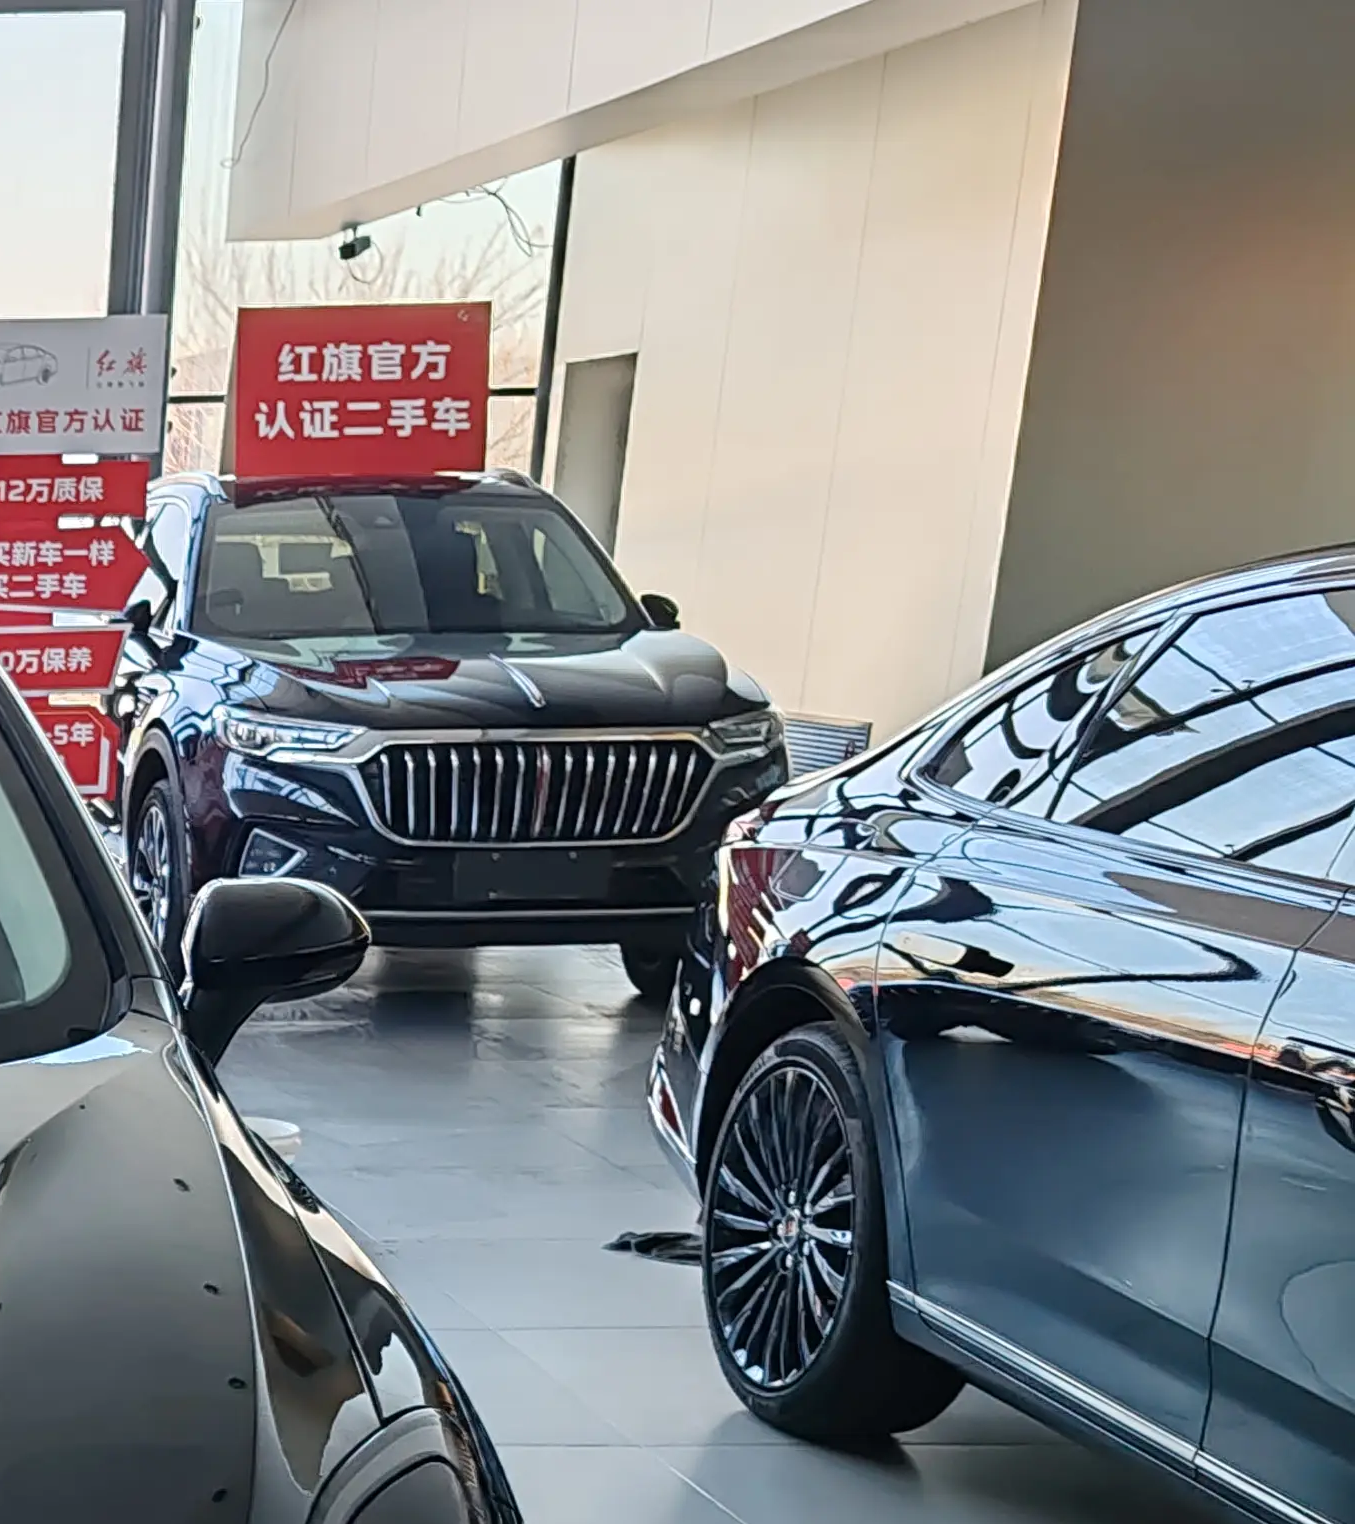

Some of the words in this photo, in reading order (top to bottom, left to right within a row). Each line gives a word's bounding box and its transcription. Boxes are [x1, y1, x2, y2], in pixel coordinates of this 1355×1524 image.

[96, 347, 147, 377] 红旗
[278, 340, 451, 382] 红旗官方
[254, 397, 471, 440] 认证二手车
